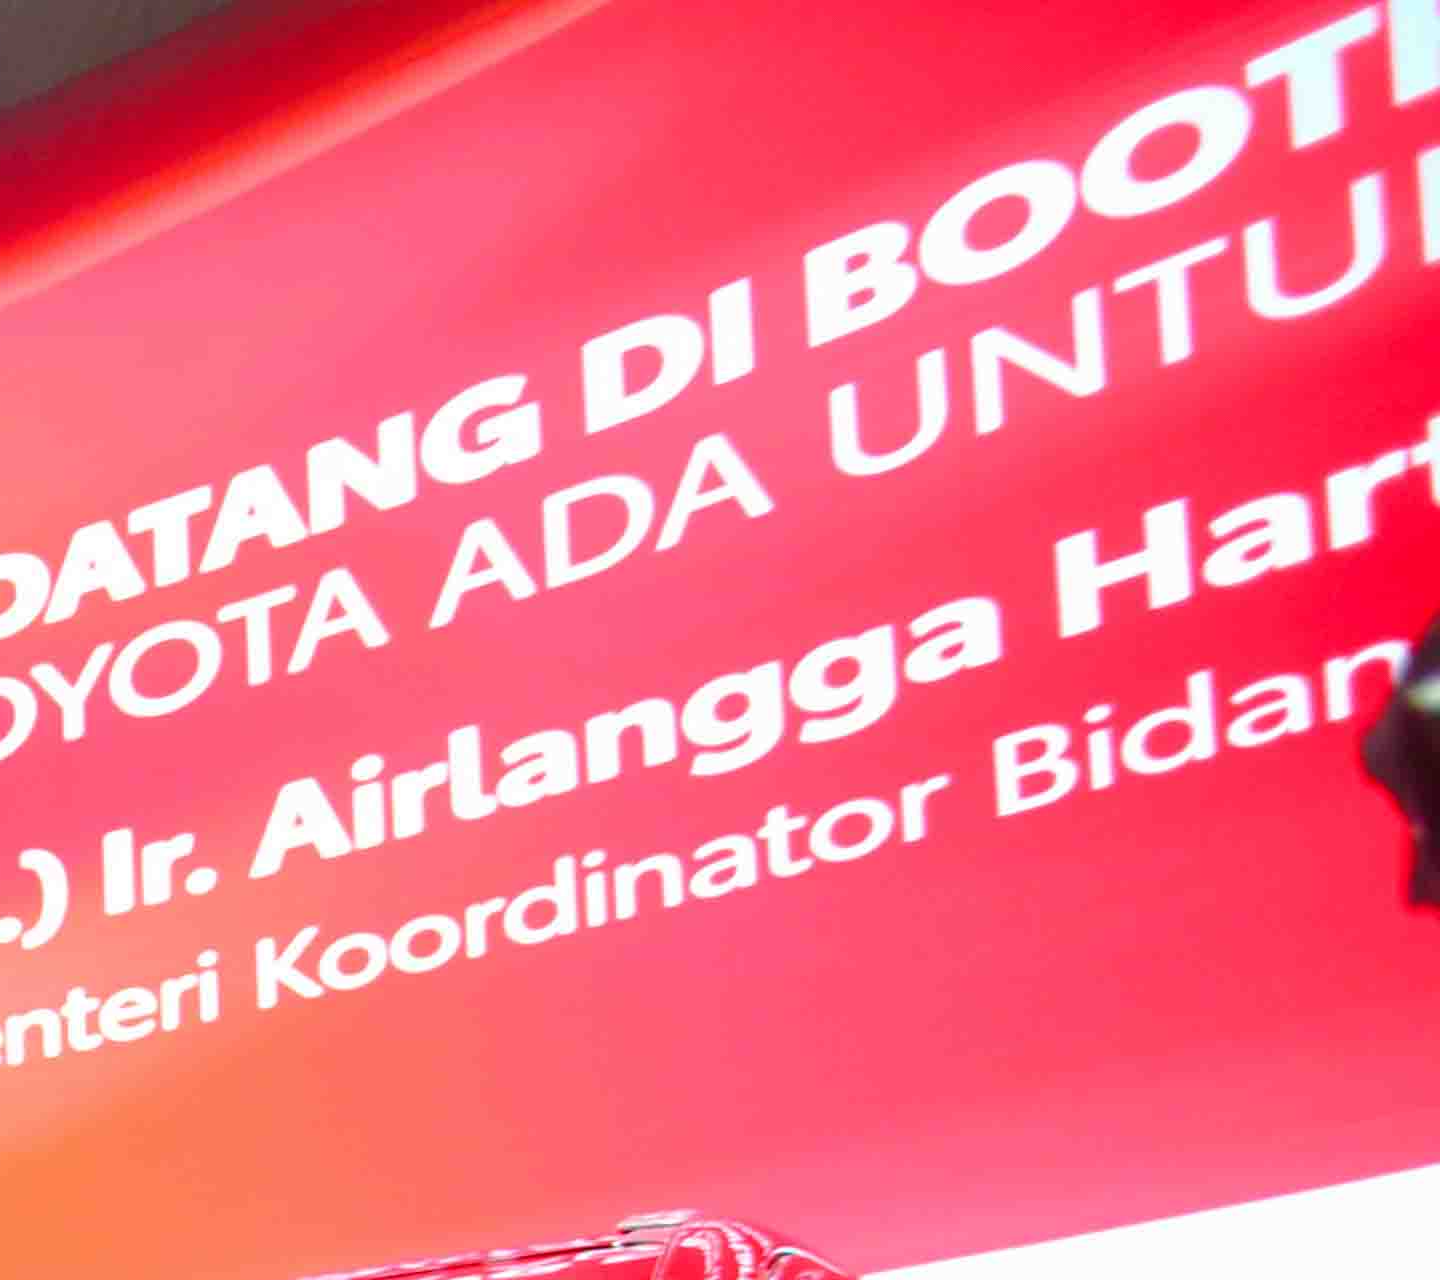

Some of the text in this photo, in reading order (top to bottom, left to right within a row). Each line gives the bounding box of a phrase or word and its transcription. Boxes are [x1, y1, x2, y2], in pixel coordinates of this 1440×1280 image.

[428, 433, 775, 629] ADA
[828, 146, 1440, 477] UNTU
[580, 277, 755, 435] DI
[101, 827, 218, 916] Ir.
[247, 597, 1001, 880] Airlangga
[254, 774, 949, 1010] Koordinator
